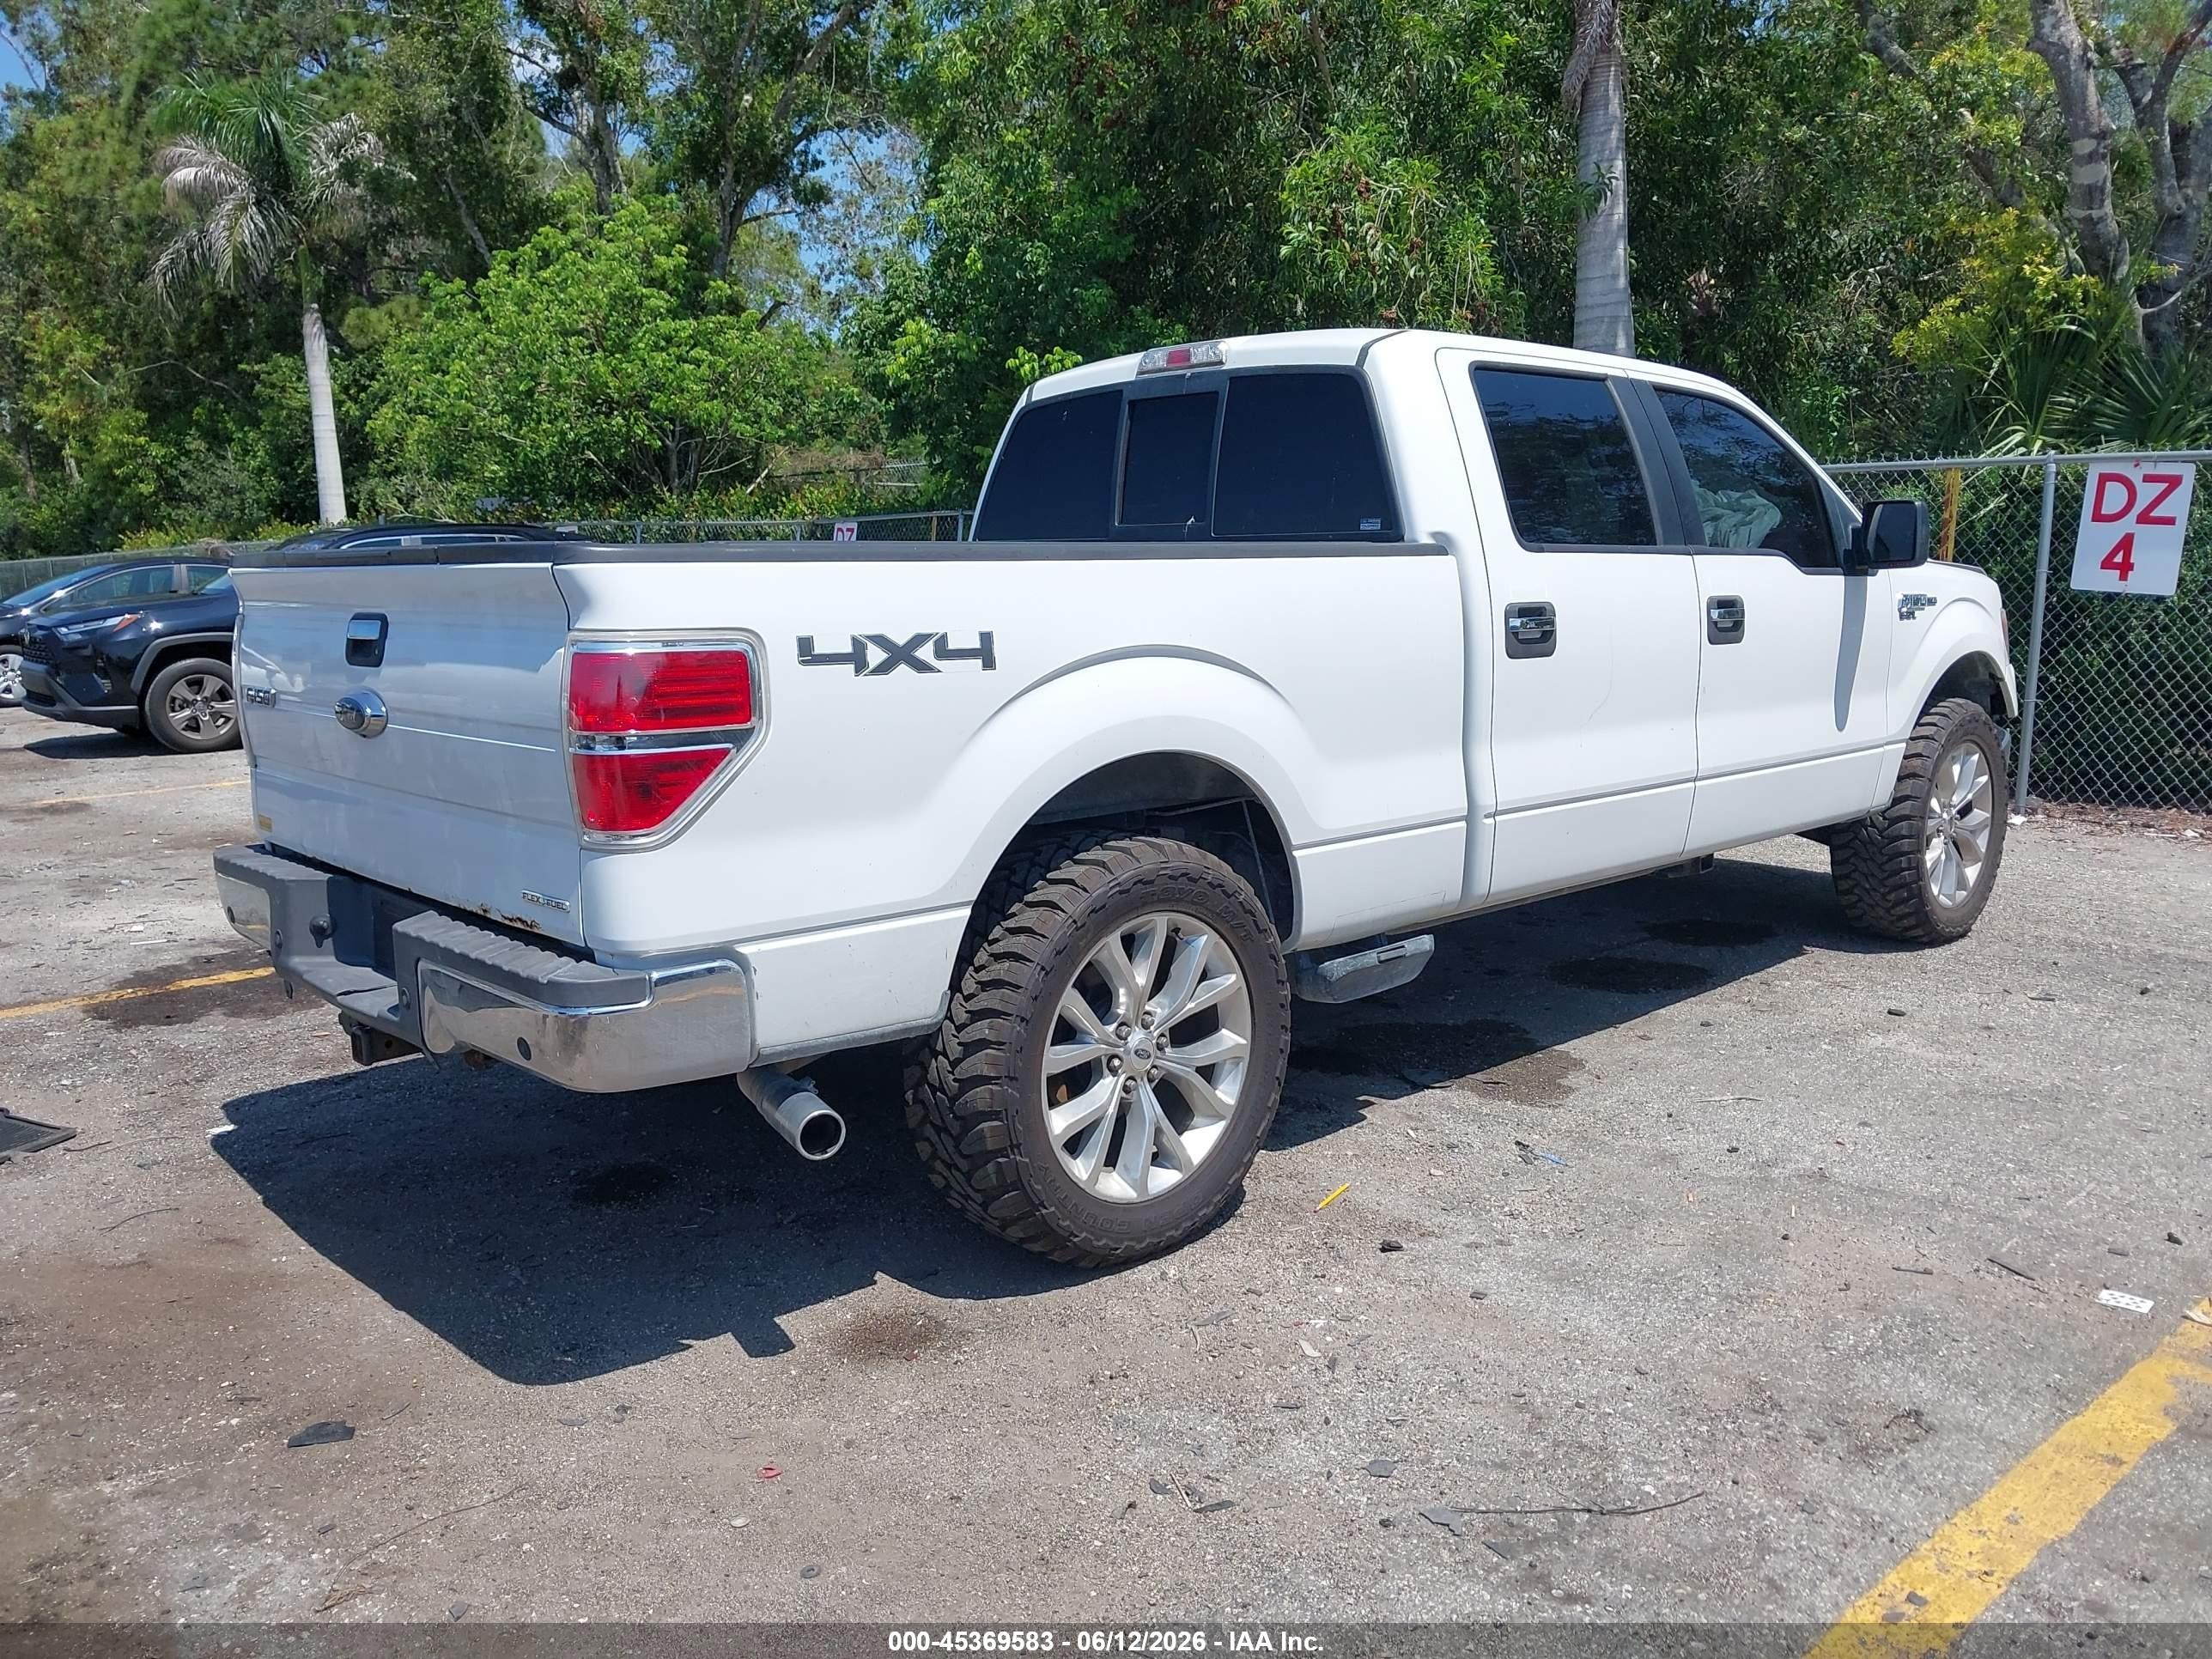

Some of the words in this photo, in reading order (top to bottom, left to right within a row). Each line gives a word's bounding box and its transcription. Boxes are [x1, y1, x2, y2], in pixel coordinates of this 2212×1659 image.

[2091, 472, 2184, 526] DZ
[2100, 532, 2136, 582] 4
[796, 630, 996, 677] 4X4
[522, 892, 544, 904] FLEX
[546, 898, 568, 910] FUEL
